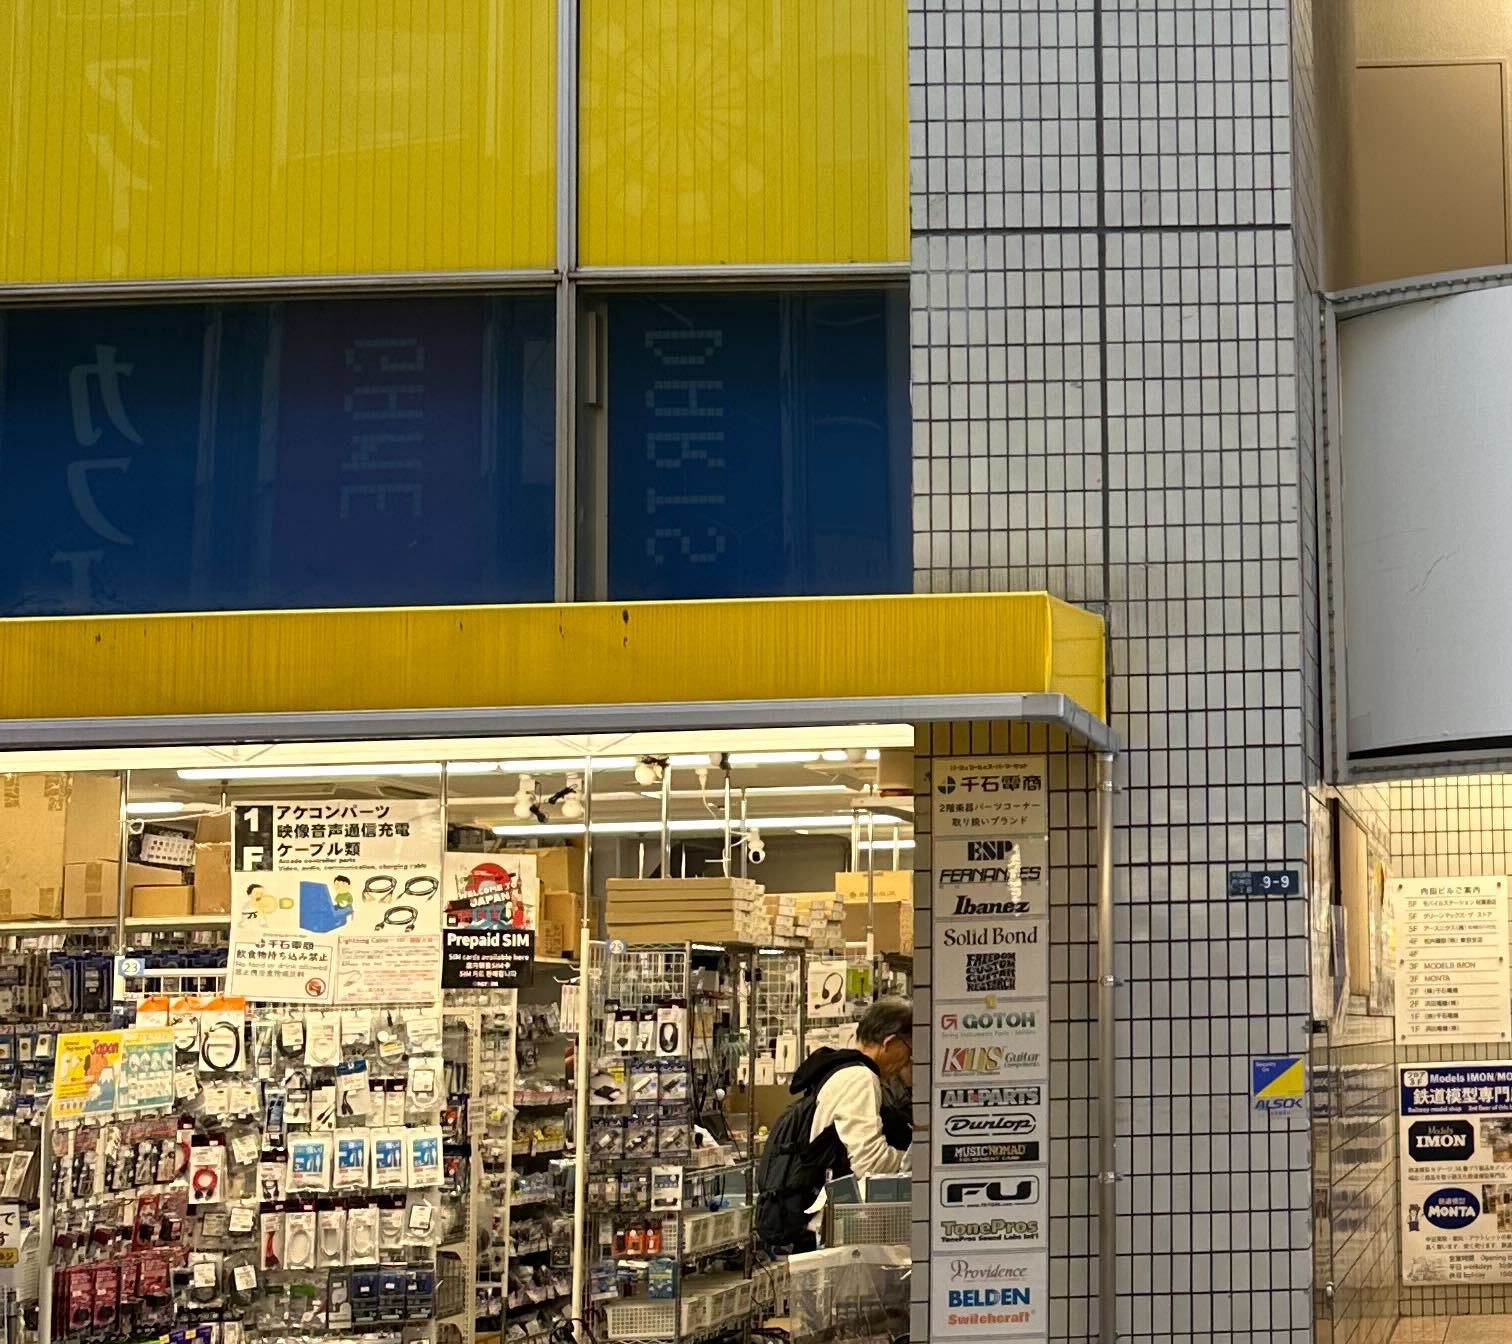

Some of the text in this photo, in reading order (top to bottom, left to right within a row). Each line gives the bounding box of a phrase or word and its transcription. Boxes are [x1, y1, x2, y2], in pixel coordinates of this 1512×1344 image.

[961, 775, 1041, 792] 千石電商
[277, 806, 390, 820] アケコンパーツ
[277, 822, 410, 839] 映像音声通信充電
[277, 842, 361, 857] ケーブル類
[968, 840, 1013, 861] ESP
[940, 866, 1041, 884] FERNANES
[1263, 875, 1290, 889] 9-9
[953, 894, 1030, 915] Ibanez
[447, 932, 530, 949] Prepaid SIM
[944, 926, 1038, 947] Solid Bond
[236, 949, 328, 962] 飲食物持ち込み禁止
[962, 1012, 1036, 1029] GOTOH
[1430, 1074, 1465, 1084] Models
[1255, 1098, 1303, 1110] ALSOK
[950, 1118, 1032, 1131] Dunlop
[1416, 1135, 1467, 1148] IMON
[1428, 1205, 1476, 1218] MONTA
[941, 1219, 1038, 1236] TonePros
[950, 1259, 1028, 1282] Providence
[948, 1288, 1031, 1307] BELDEN
[947, 1311, 1031, 1325] Switchcraft
